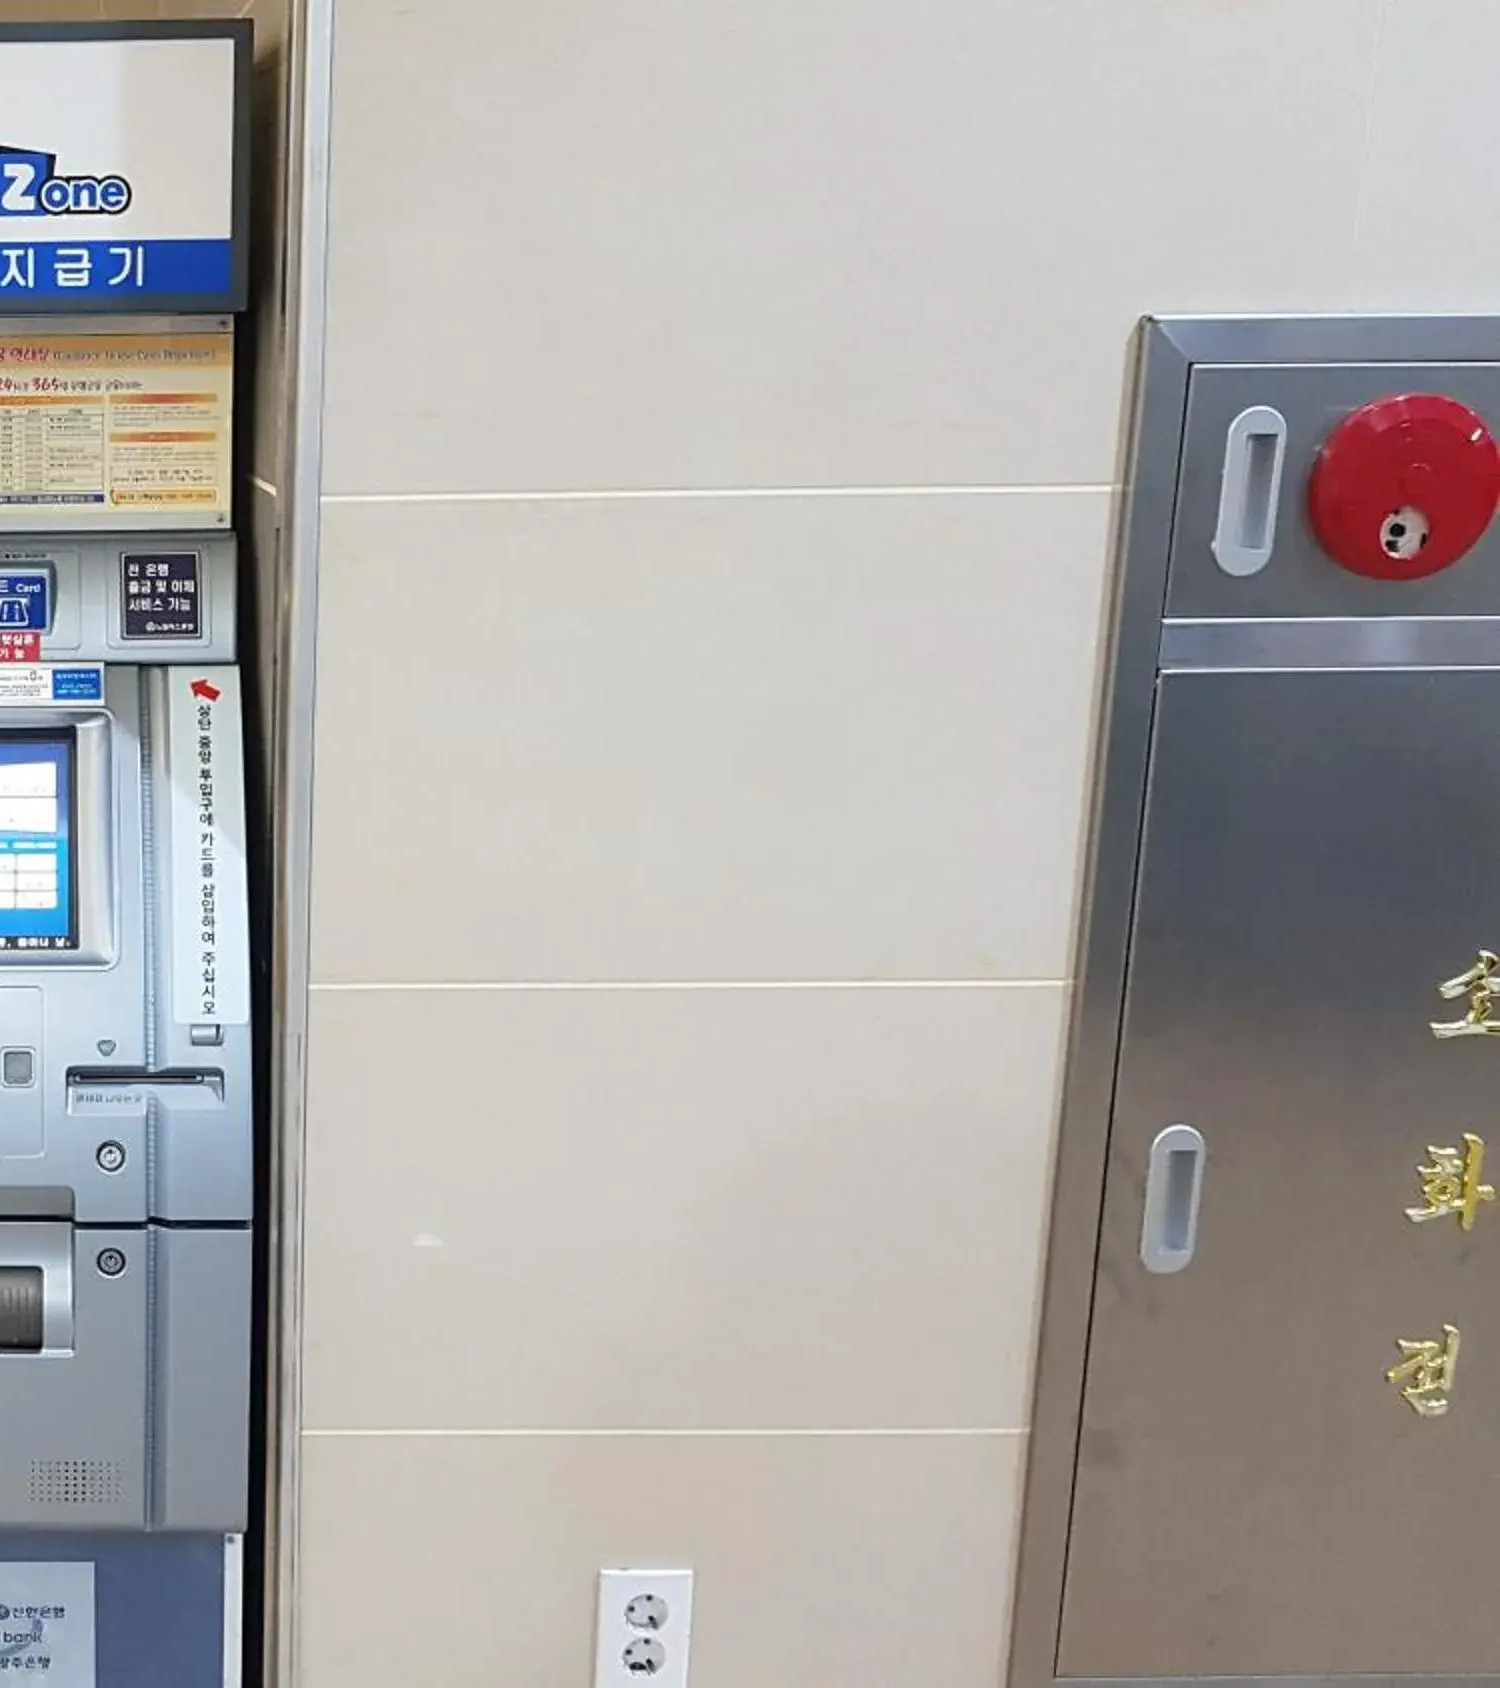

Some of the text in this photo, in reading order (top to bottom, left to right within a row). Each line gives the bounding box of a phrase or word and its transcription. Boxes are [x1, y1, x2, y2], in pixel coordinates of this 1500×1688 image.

[0, 162, 132, 214] Zone
[15, 582, 42, 593] Card
[128, 597, 191, 612] 서비스 가능
[202, 951, 216, 1015] 주십시오
[3, 1630, 44, 1643] bank
